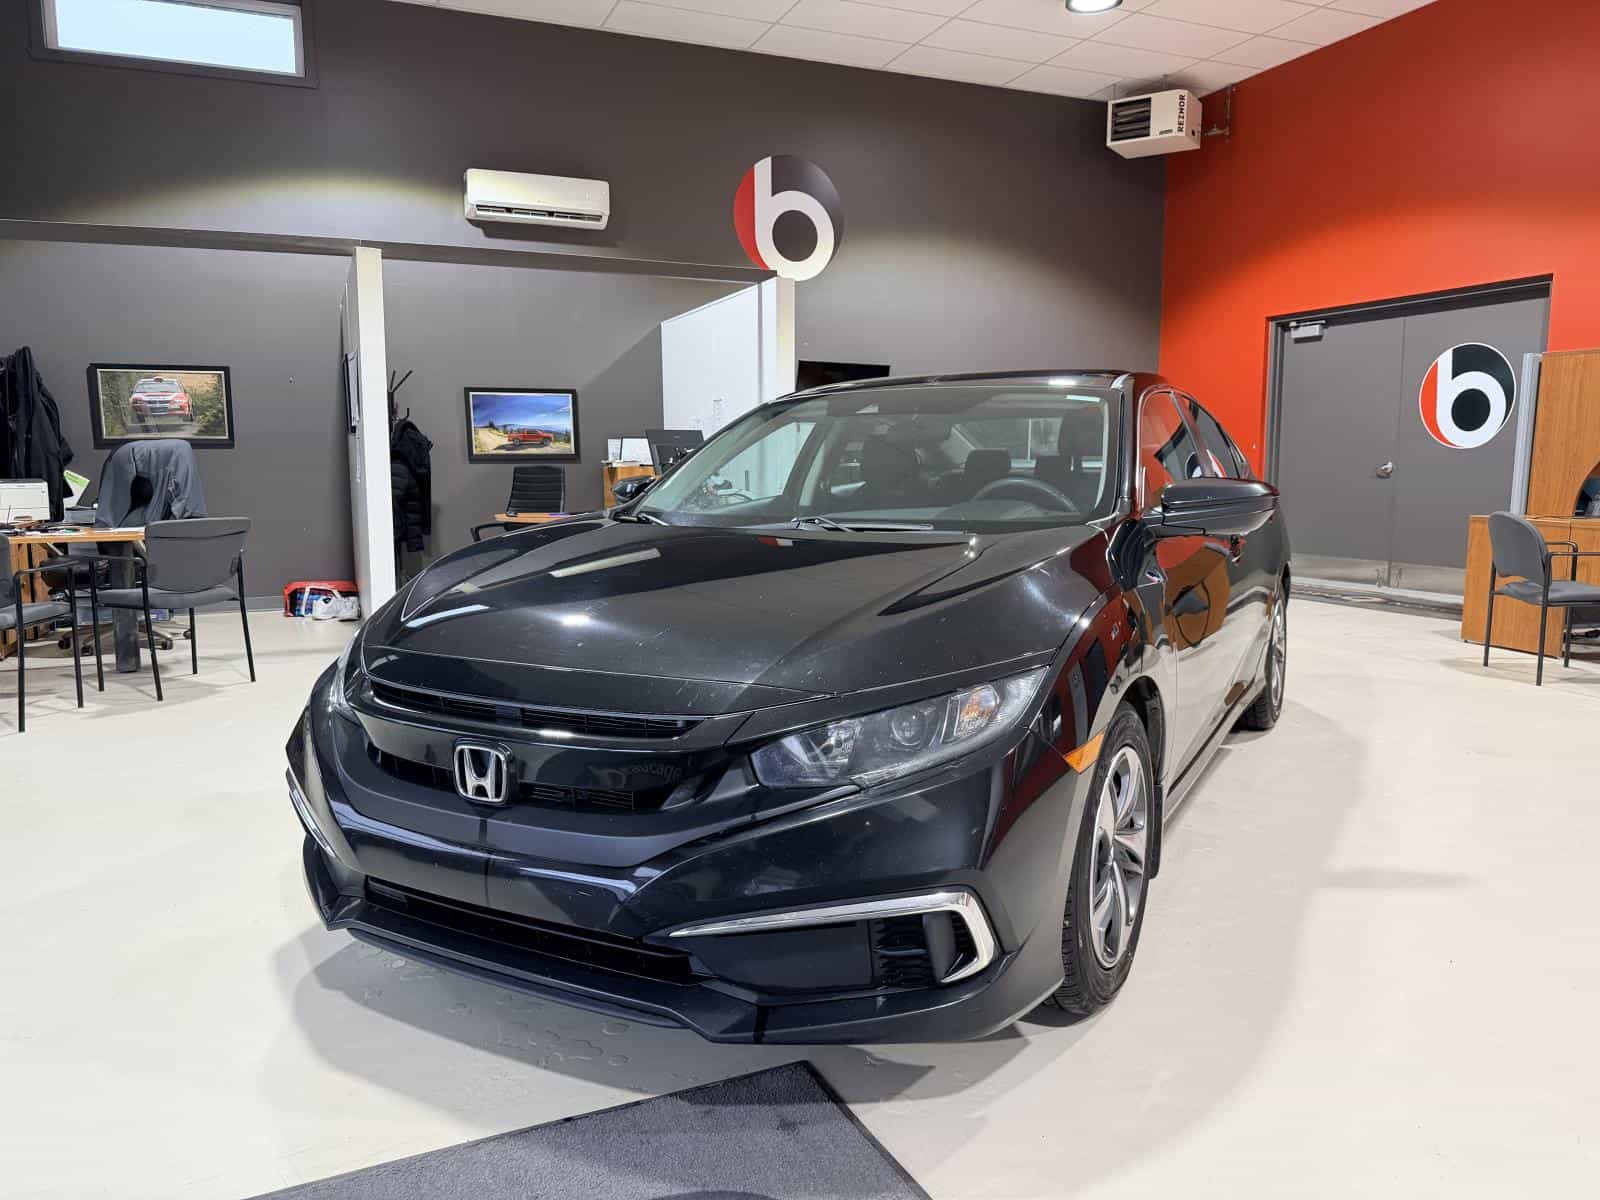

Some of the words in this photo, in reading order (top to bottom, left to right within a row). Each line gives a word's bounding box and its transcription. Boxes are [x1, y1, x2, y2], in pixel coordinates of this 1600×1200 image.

[1177, 94, 1187, 132] REZNOR
[753, 155, 836, 281] b
[1435, 346, 1508, 449] b
